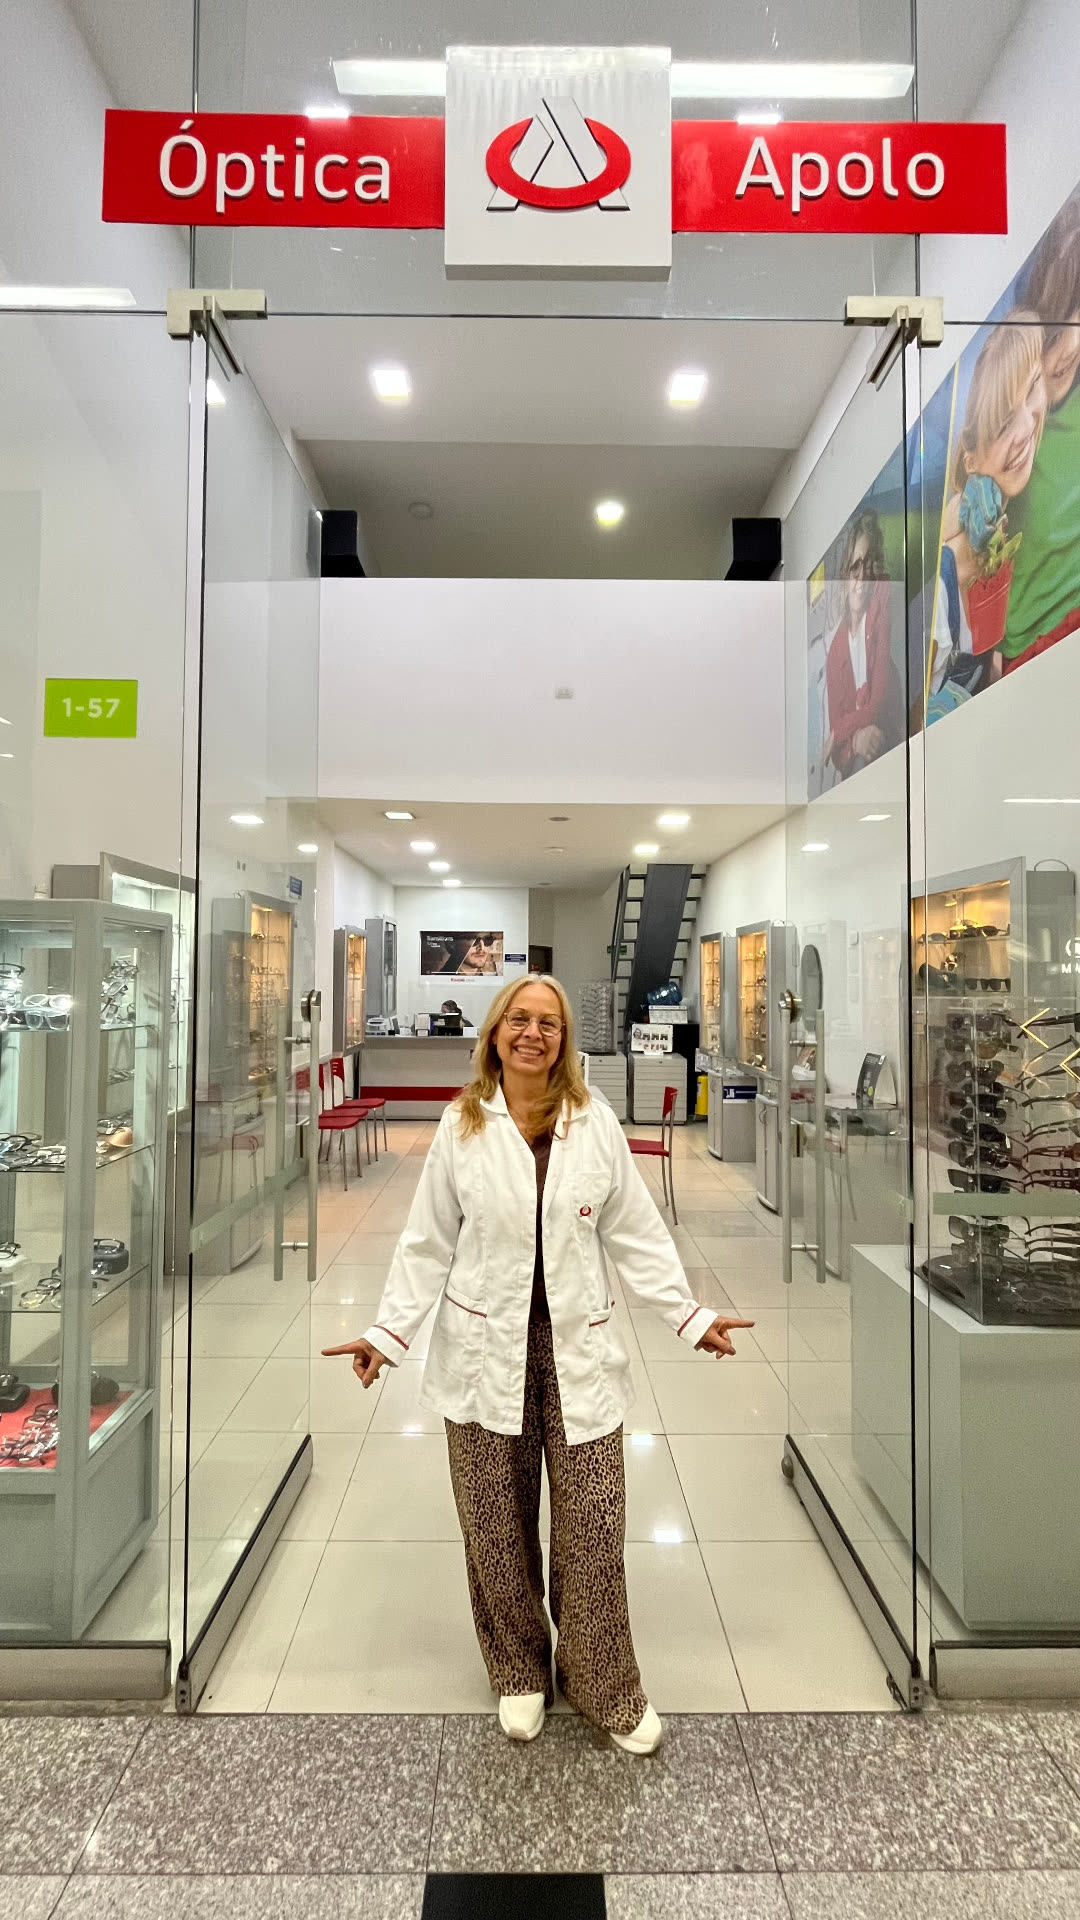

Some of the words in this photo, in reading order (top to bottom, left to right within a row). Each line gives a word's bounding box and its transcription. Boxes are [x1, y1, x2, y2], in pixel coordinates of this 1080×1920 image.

[159, 119, 390, 215] Óptica
[735, 136, 945, 215] Apolo
[62, 697, 121, 719] 1-57
